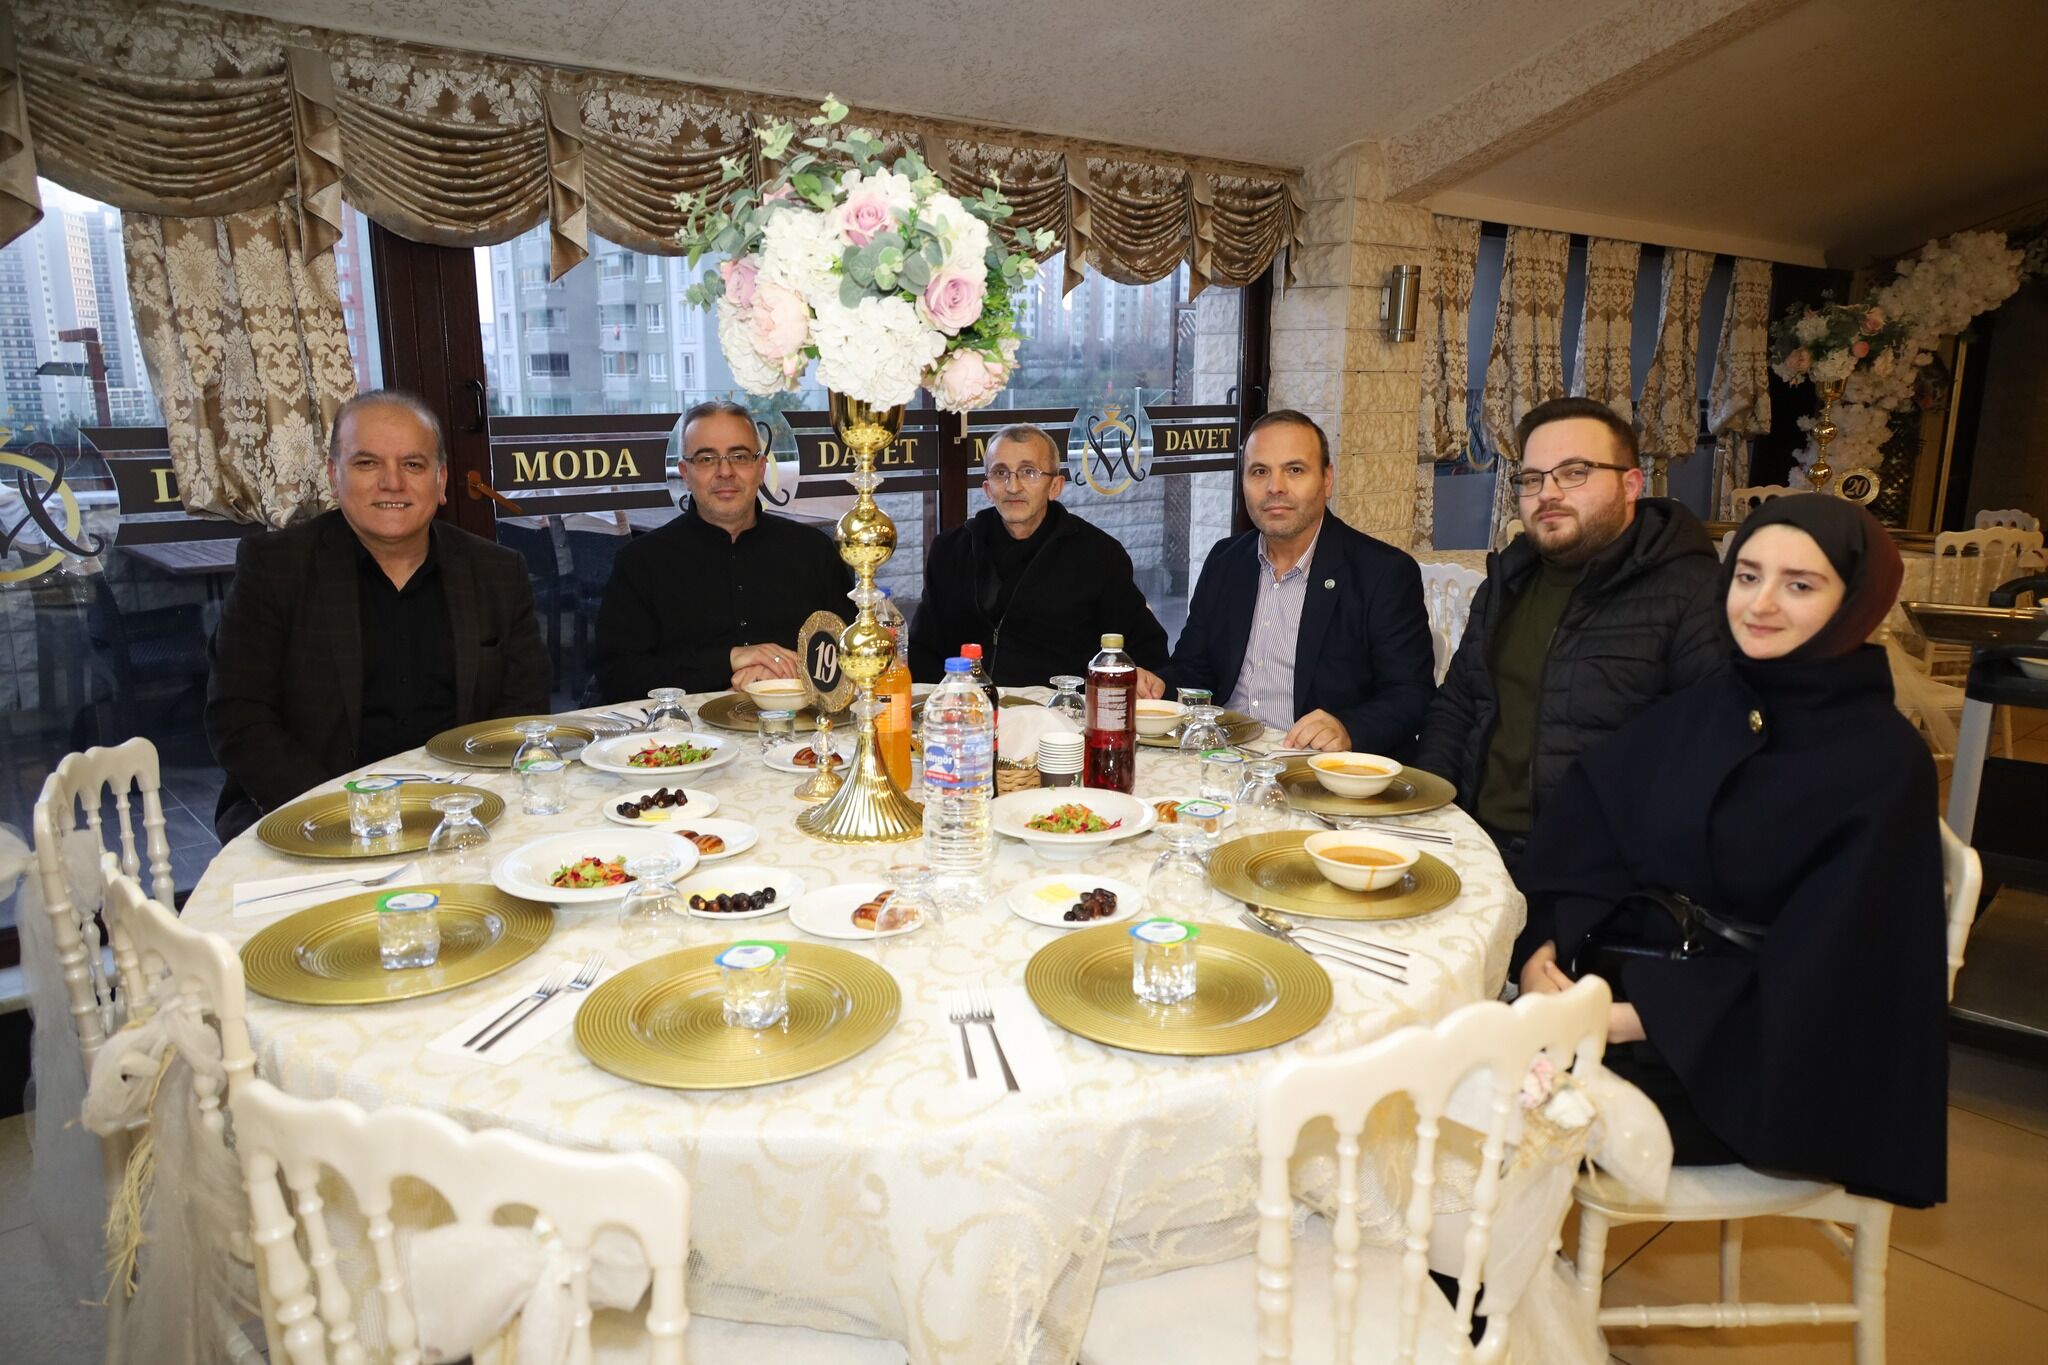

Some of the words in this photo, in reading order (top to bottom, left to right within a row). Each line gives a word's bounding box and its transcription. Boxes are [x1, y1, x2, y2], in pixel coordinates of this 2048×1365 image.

[817, 438, 918, 468] DAET
[1165, 427, 1232, 451] DAVET
[511, 447, 641, 483] MODA
[1844, 478, 1868, 497] 20
[812, 641, 838, 684] 19
